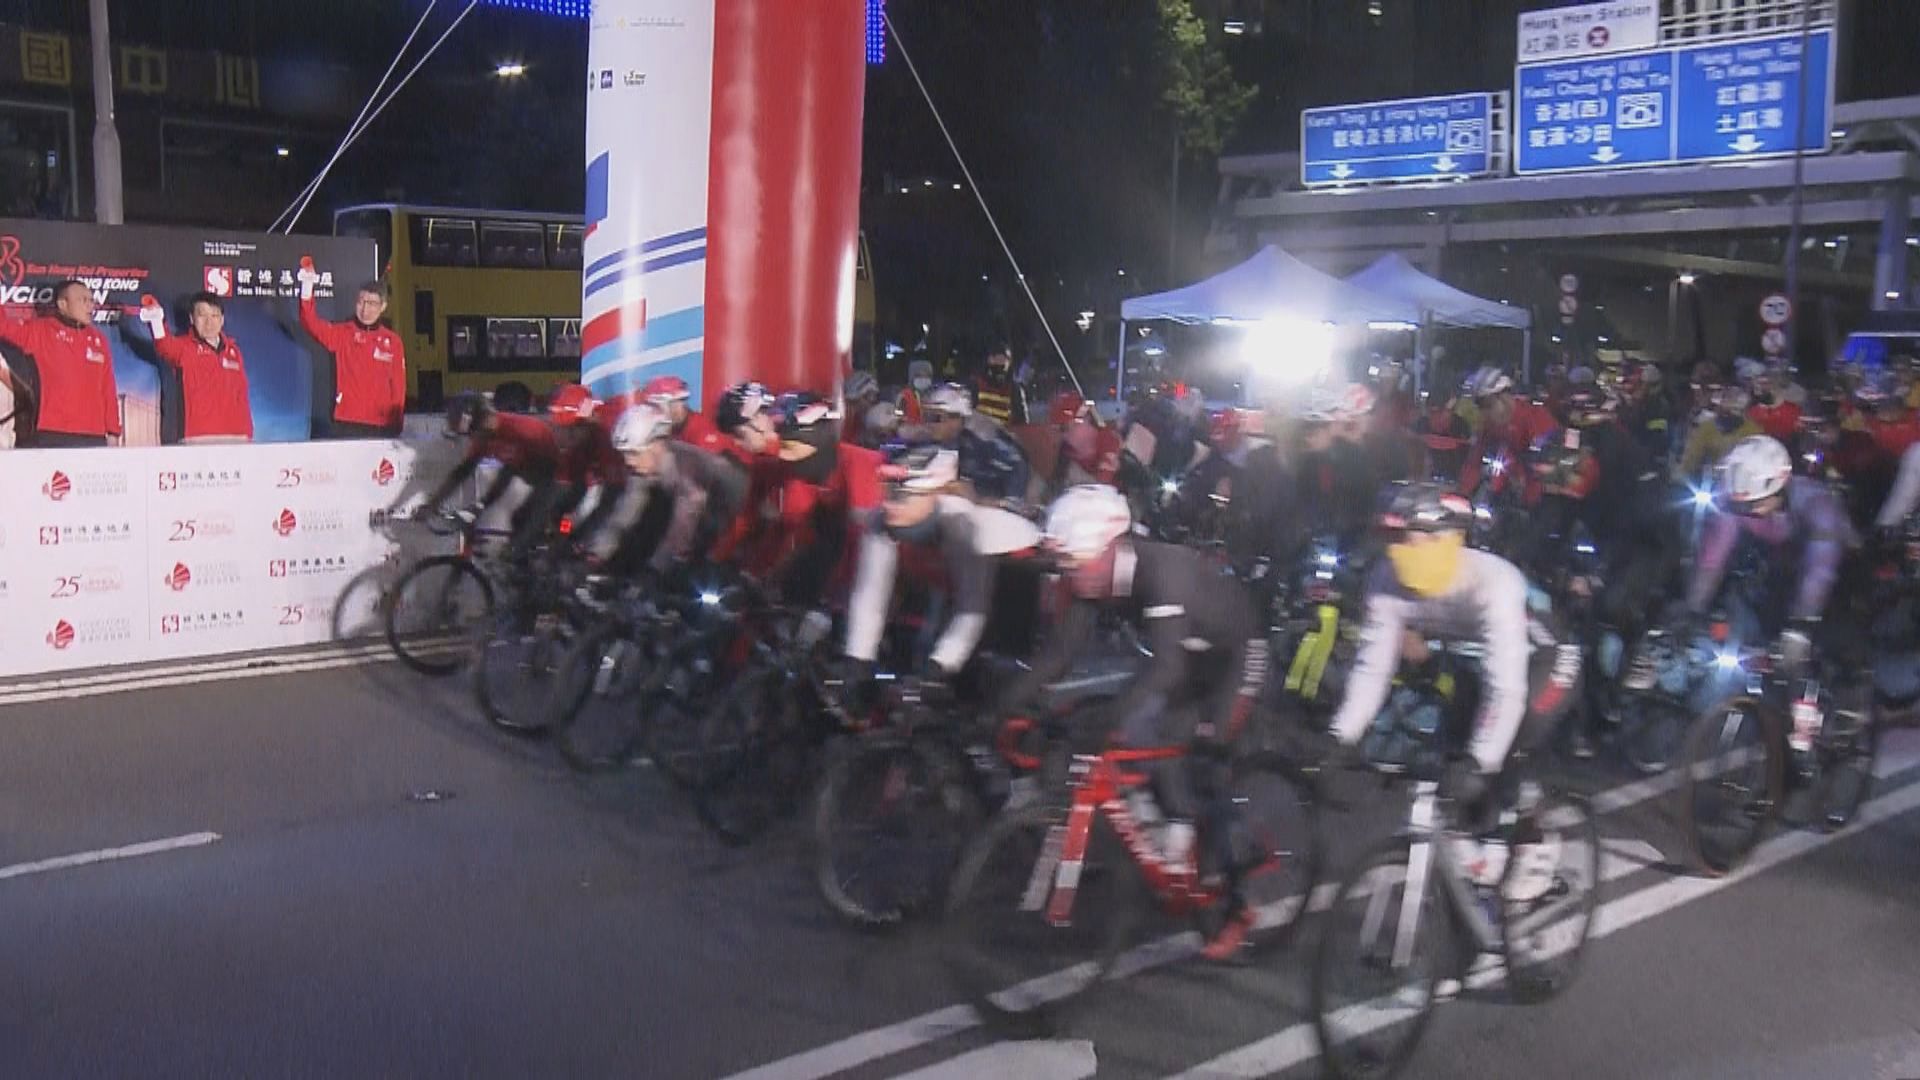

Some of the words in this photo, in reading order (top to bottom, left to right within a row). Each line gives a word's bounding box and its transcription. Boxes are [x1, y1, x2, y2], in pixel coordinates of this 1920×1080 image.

[1597, 5, 1651, 21] Station
[102, 278, 139, 291] KONG
[237, 268, 335, 287] 新鴻基產
[276, 467, 302, 488] 25
[168, 519, 198, 541] 25
[50, 574, 82, 598] 25
[278, 604, 304, 625] 25
